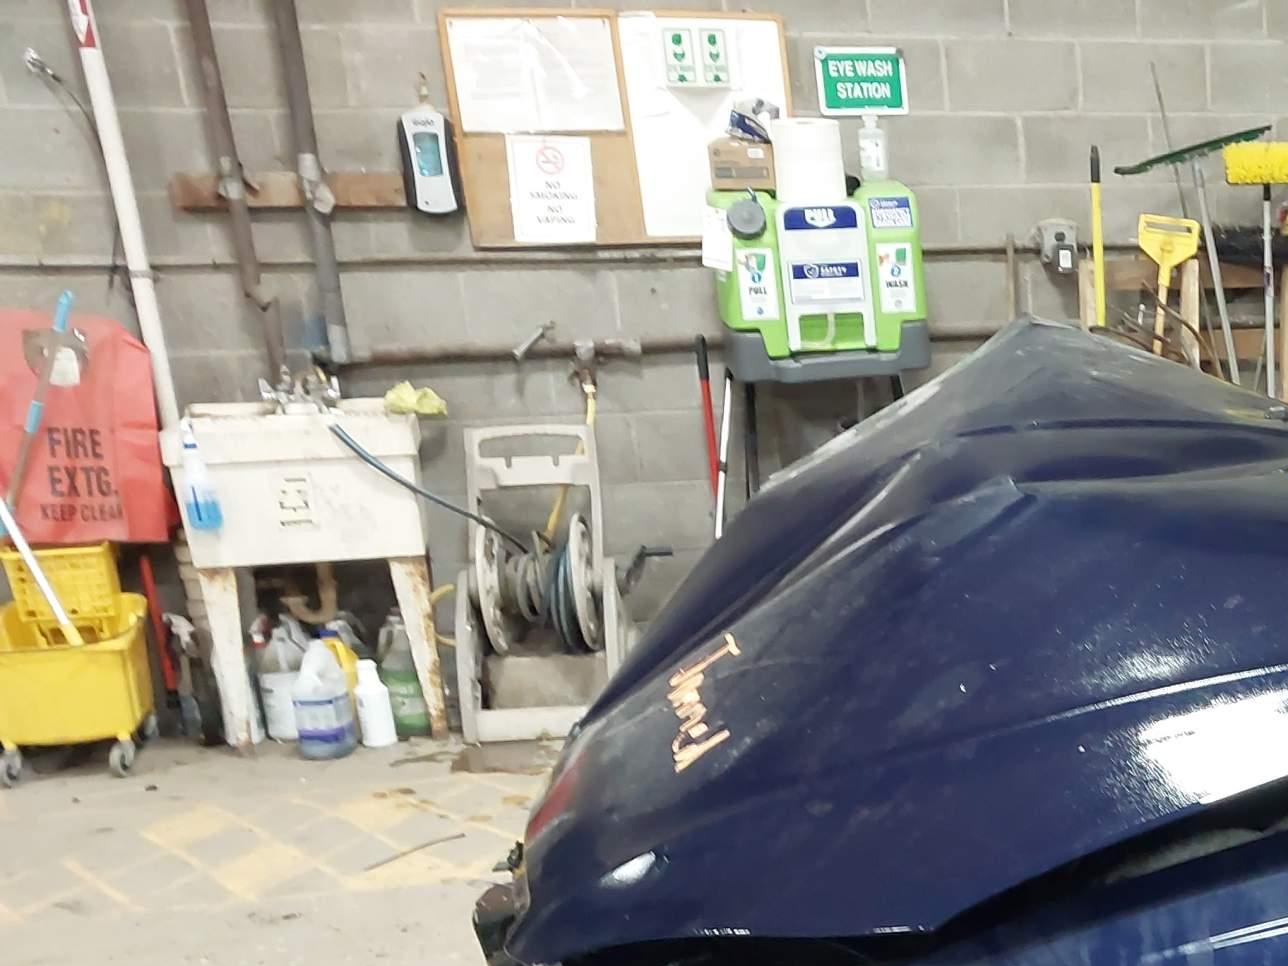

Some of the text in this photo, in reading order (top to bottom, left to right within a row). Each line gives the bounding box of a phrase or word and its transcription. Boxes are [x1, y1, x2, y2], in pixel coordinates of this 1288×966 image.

[827, 59, 894, 77] EYE WASH
[836, 82, 892, 99] STATION
[544, 181, 561, 190] NO
[46, 426, 104, 459] FIRE
[47, 466, 119, 498] EXTG.
[40, 503, 77, 521] KEEP
